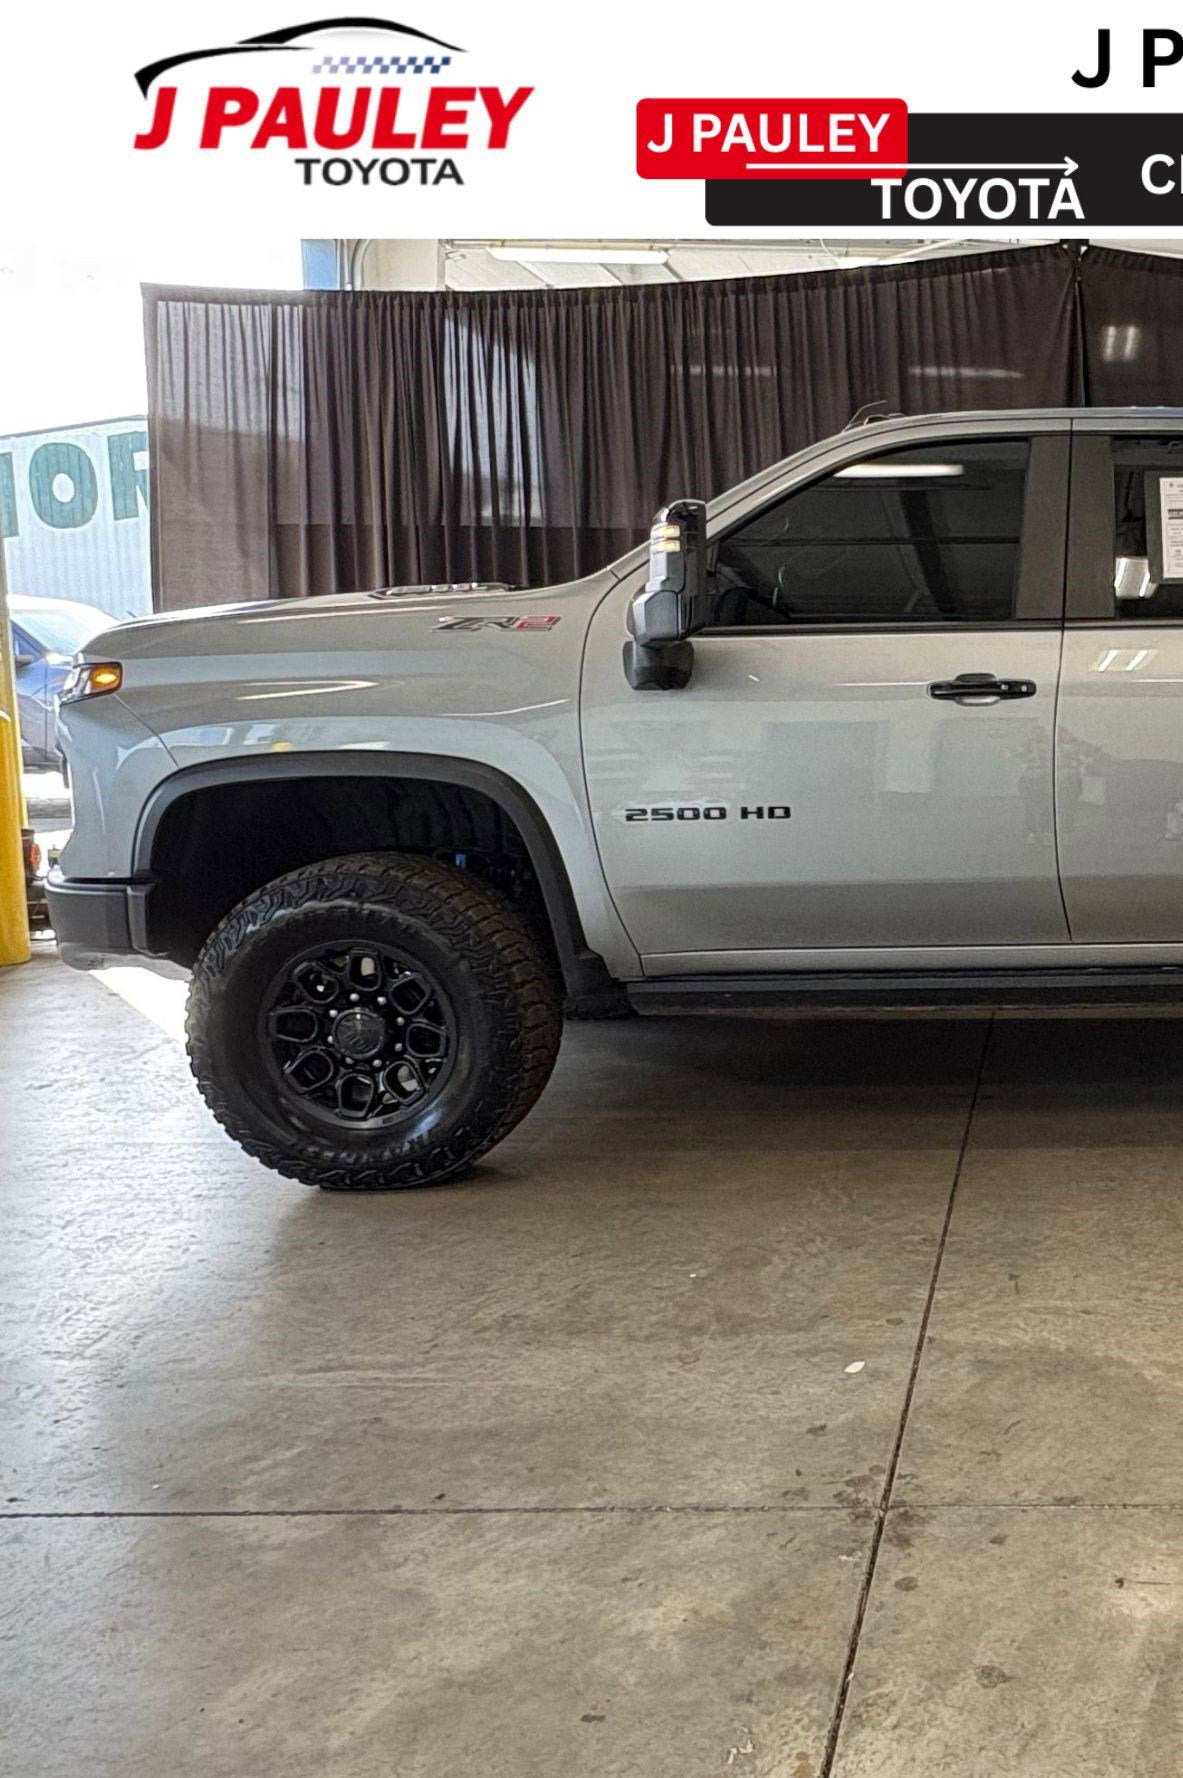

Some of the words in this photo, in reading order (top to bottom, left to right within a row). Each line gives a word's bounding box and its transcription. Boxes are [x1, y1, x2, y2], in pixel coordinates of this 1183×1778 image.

[0, 431, 149, 538] OR
[432, 615, 562, 632] ZR2
[624, 806, 727, 822] 2500
[740, 806, 791, 820] HD
